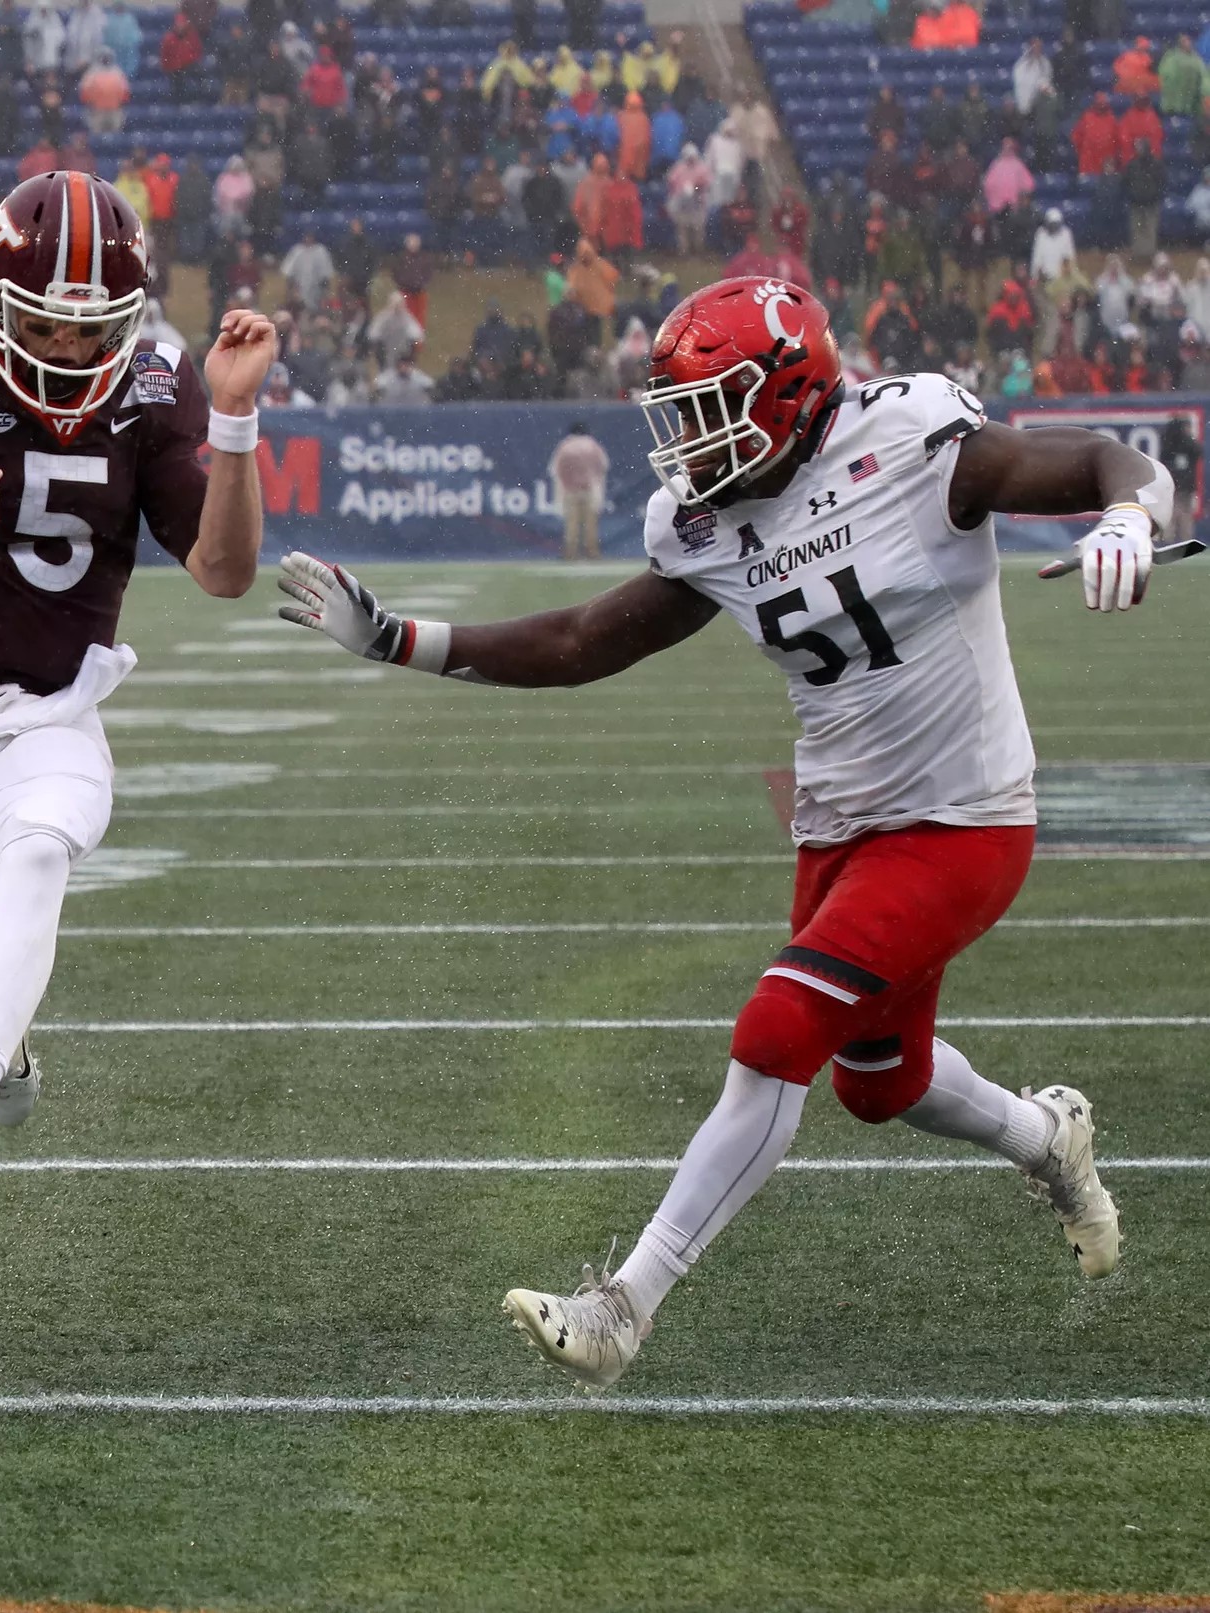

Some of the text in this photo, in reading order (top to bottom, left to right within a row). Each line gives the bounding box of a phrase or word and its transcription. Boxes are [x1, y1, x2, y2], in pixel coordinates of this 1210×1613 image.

[63, 287, 93, 297] ACC
[136, 373, 178, 386] MILITARY
[144, 383, 171, 394] BOWL
[52, 418, 83, 435] VT
[339, 435, 494, 473] Science.
[337, 480, 483, 524] Applied
[490, 483, 529, 516] to
[8, 450, 109, 593] 5
[677, 516, 718, 538] MILITARY
[688, 529, 713, 543] BOWL
[747, 524, 852, 588] CINCINNATI
[756, 565, 905, 687] 51
